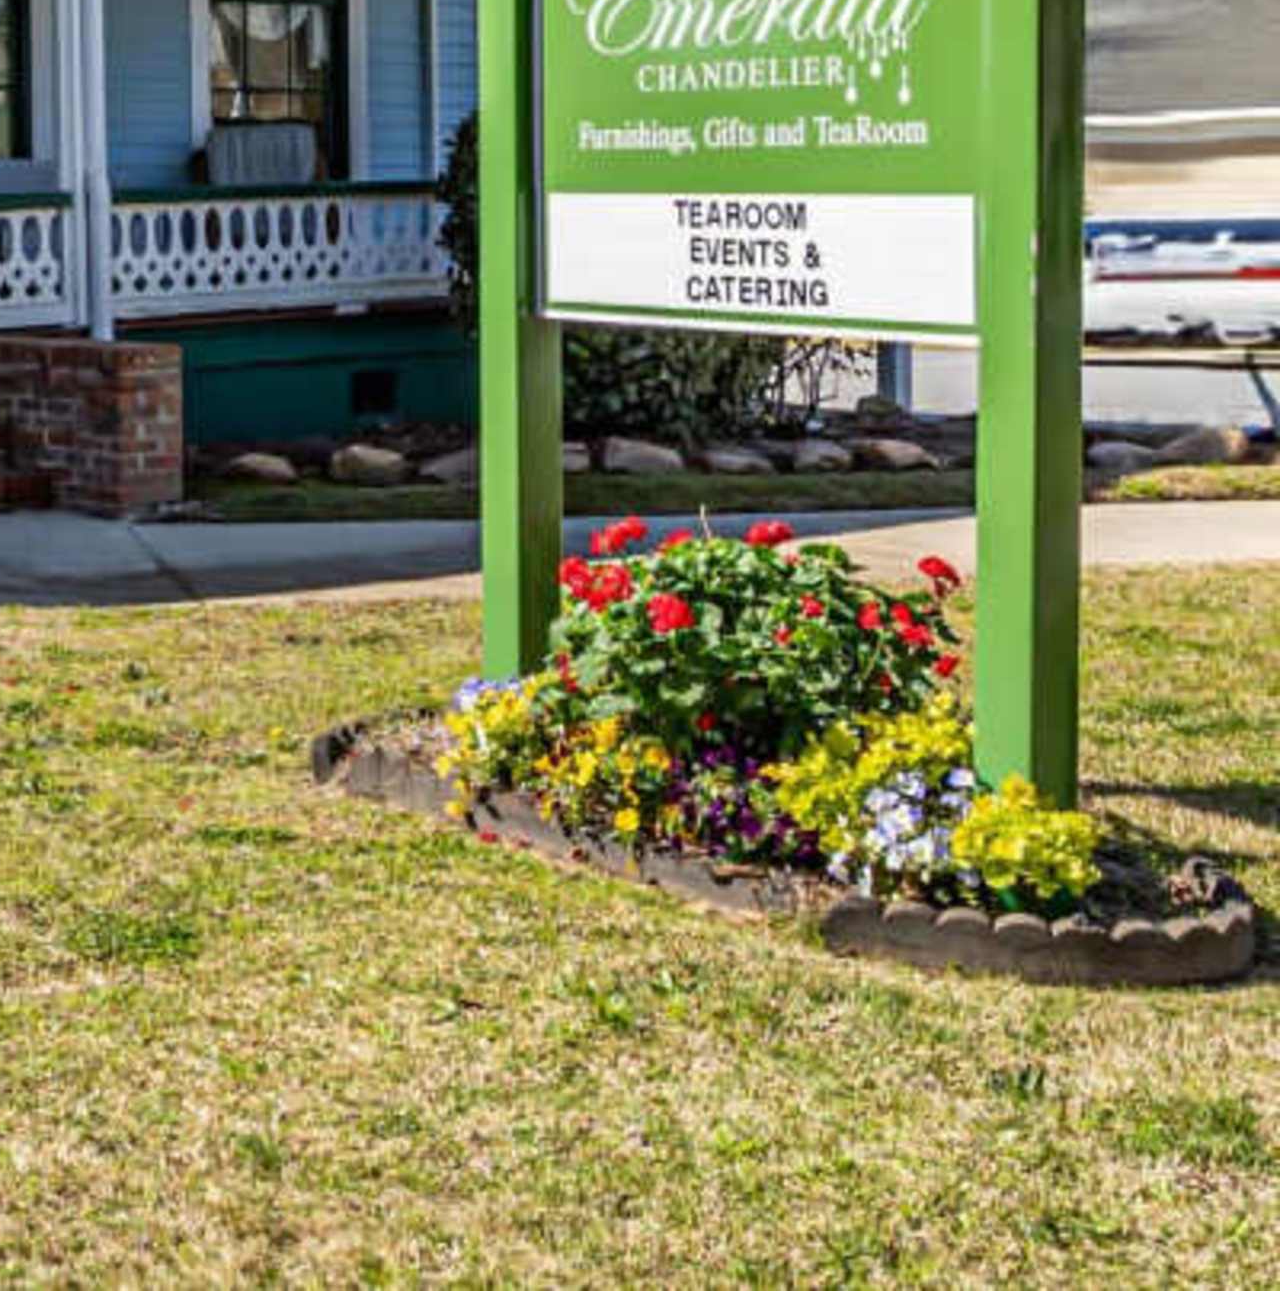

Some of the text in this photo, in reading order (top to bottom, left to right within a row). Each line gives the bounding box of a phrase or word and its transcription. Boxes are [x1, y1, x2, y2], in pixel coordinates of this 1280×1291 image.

[637, 55, 845, 92] CHANDELIER
[578, 116, 929, 154] Furnishings, Gifts and TeaRoom
[674, 200, 807, 230] TEAROOM
[689, 237, 821, 269] EVENTS &
[686, 276, 829, 307] CATERING
